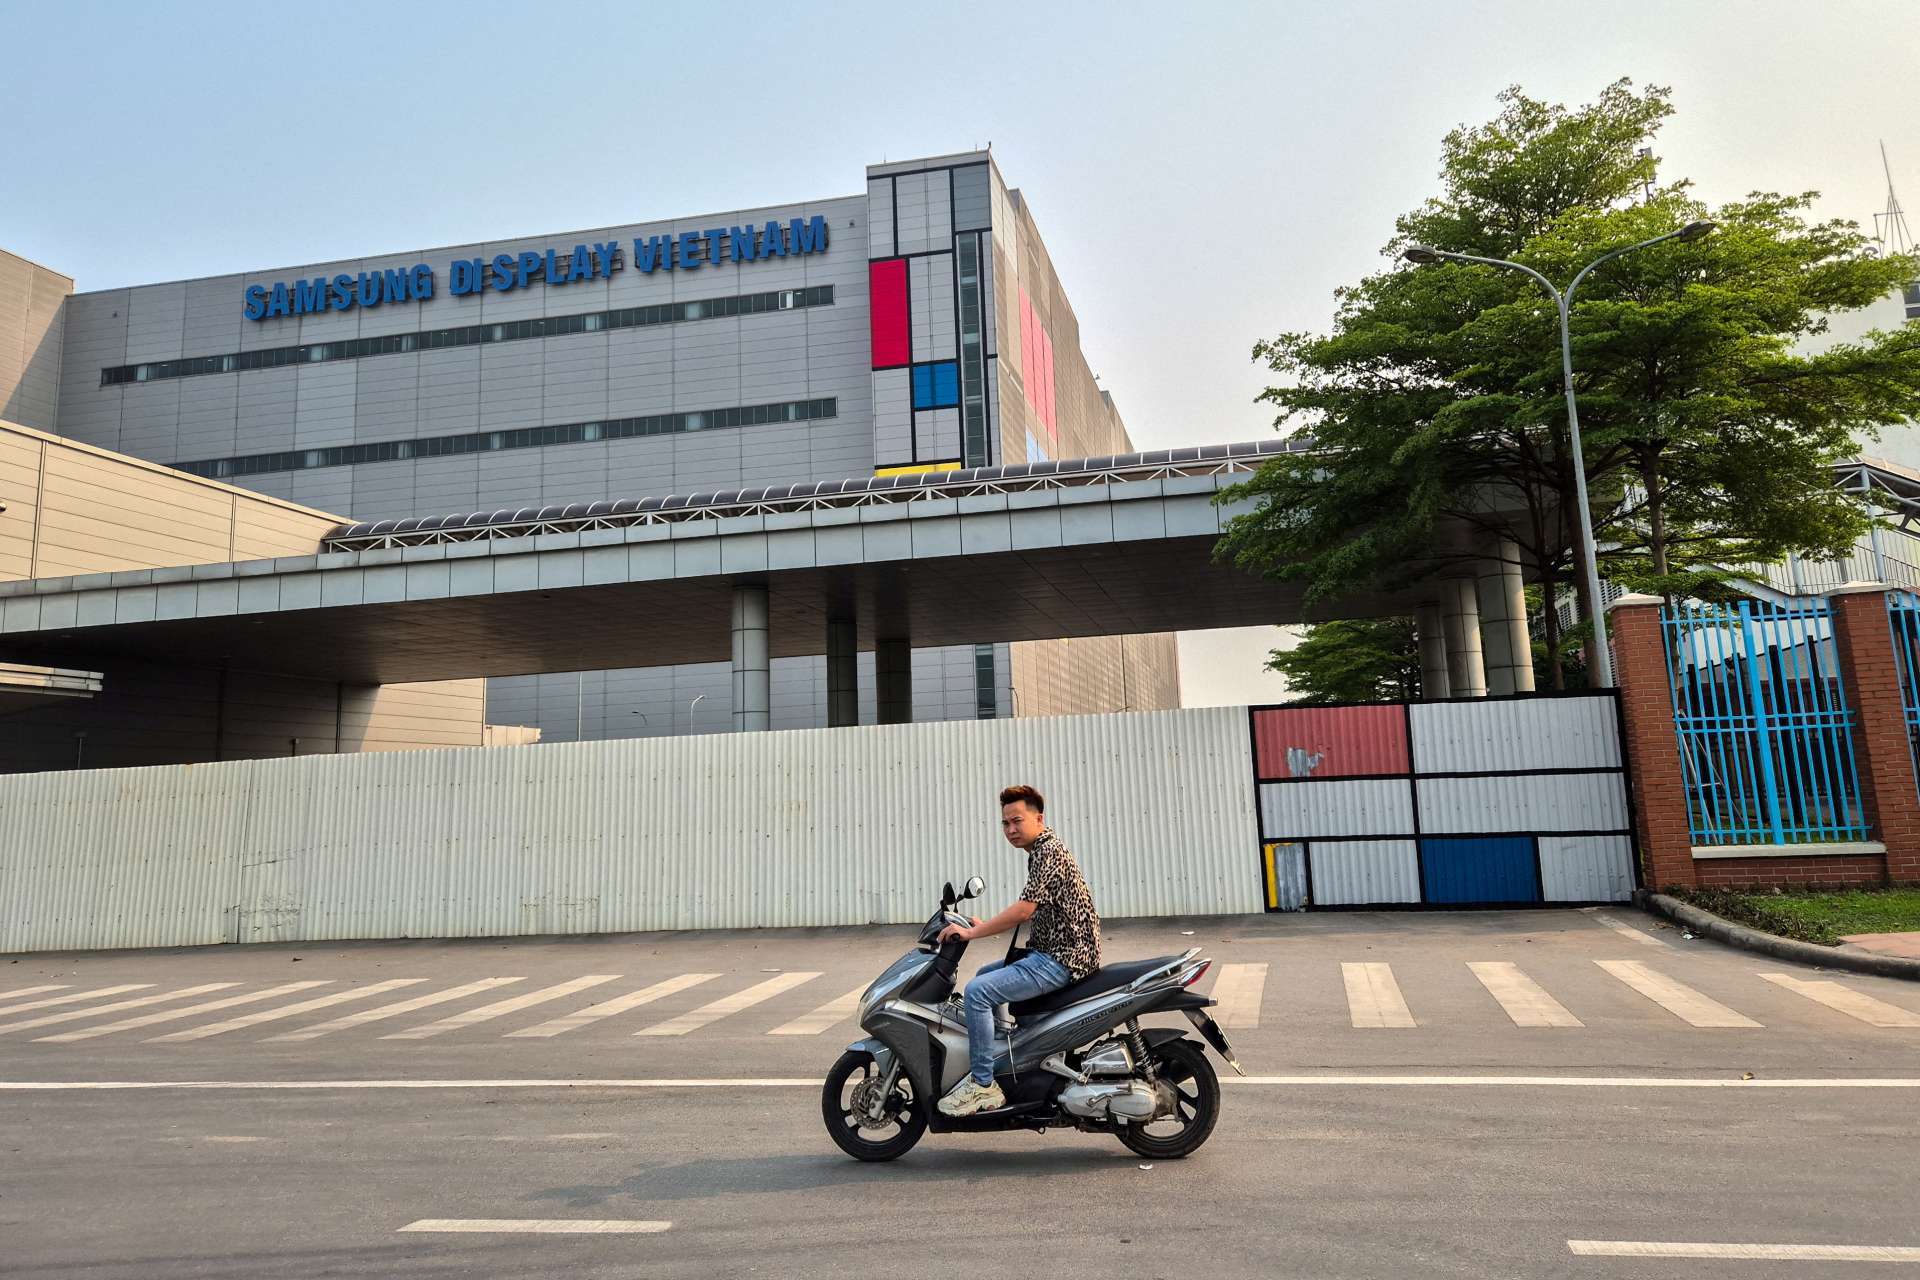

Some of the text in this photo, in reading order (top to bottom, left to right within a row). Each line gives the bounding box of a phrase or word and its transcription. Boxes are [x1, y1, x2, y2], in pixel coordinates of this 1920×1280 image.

[244, 216, 827, 322] SAMSUNG DISPLAY VIETNAM
